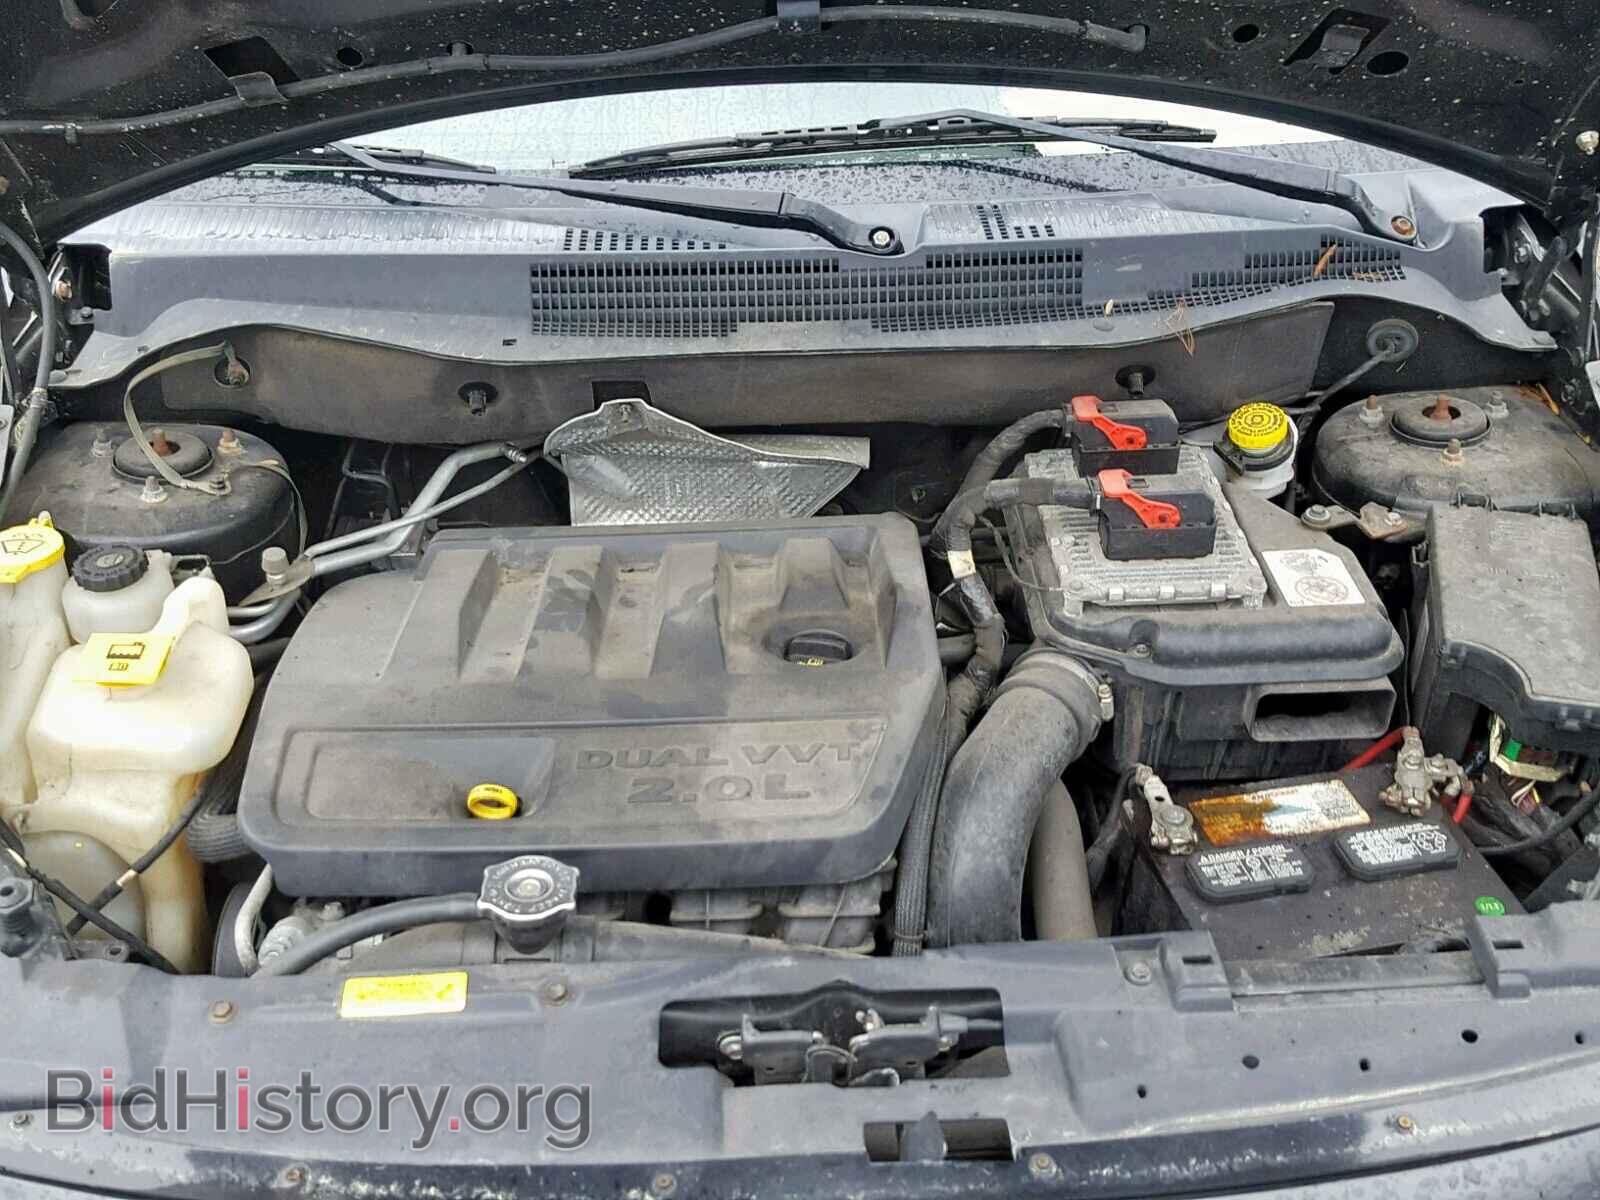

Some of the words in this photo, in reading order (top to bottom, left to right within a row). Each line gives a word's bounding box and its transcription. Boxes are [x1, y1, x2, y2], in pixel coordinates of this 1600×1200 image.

[576, 747, 729, 770] DUAL
[741, 742, 860, 764] VVT
[627, 773, 811, 804] 2.0L
